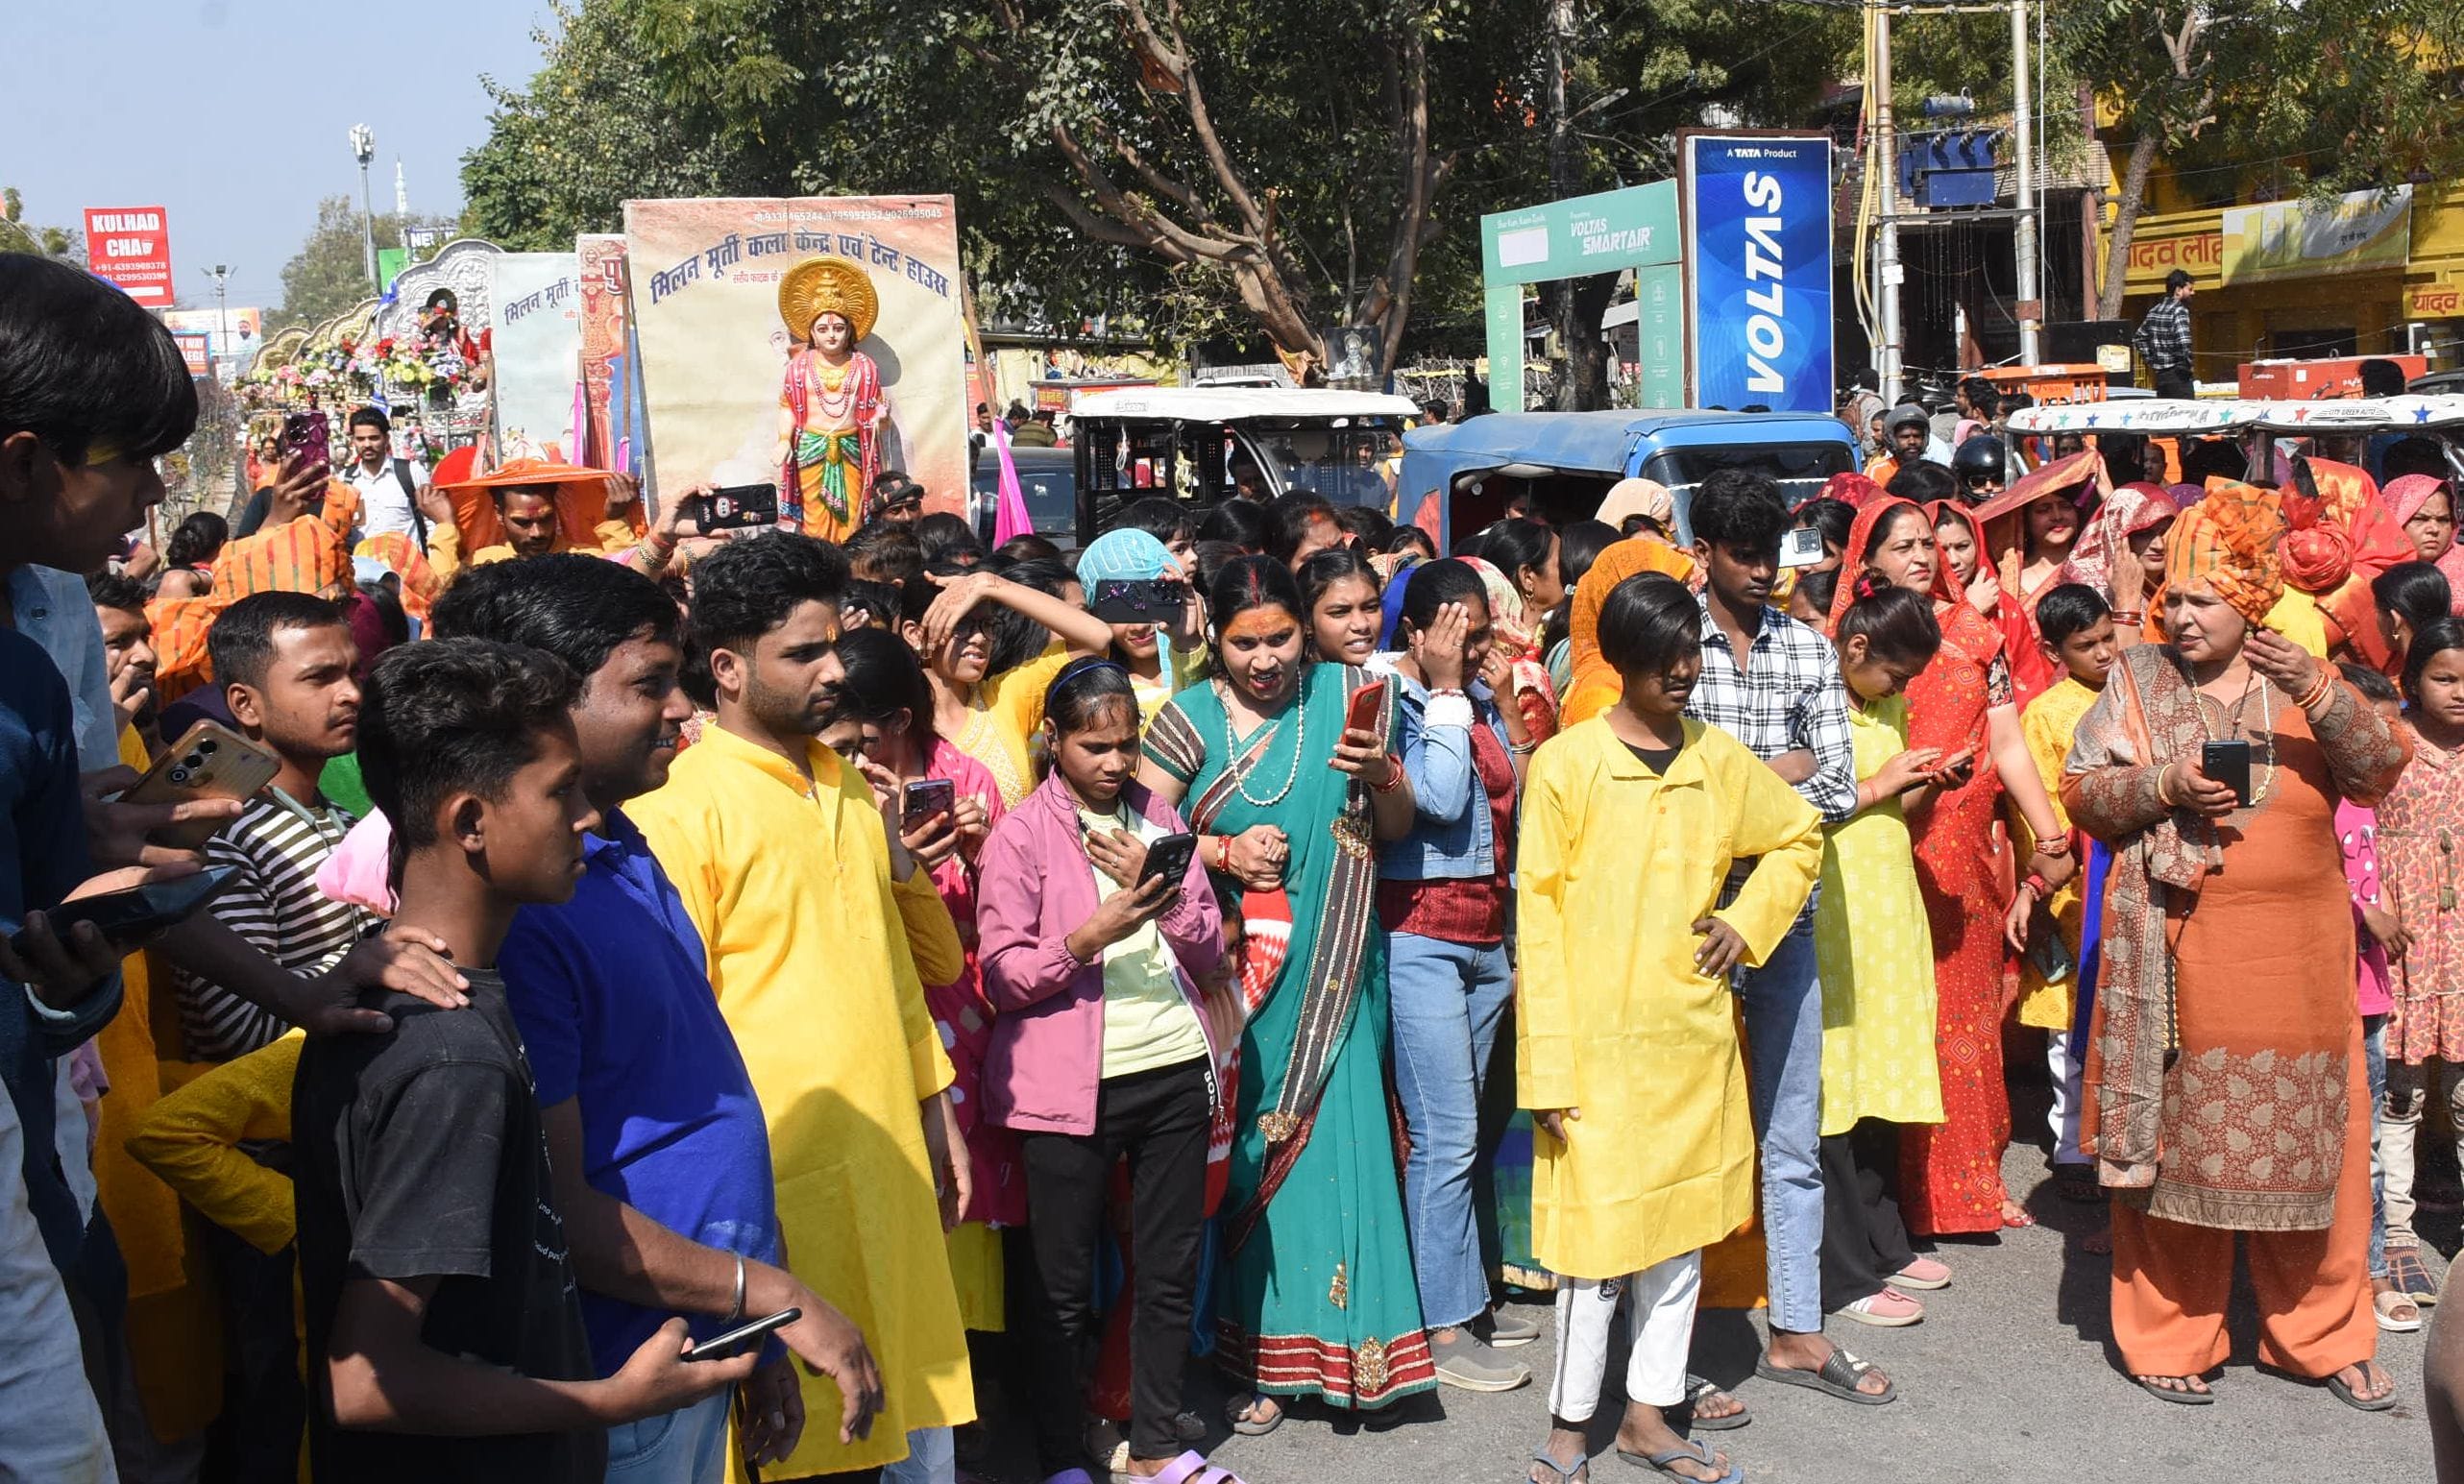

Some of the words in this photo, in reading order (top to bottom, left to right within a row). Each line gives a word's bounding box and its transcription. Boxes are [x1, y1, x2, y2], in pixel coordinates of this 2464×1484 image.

[1727, 149, 1733, 158] A
[1735, 149, 1762, 158] TATA
[1764, 149, 1796, 158] Product
[91, 213, 159, 232] KULHAD
[1571, 218, 1607, 237] VOLTAS
[650, 254, 700, 304] मिलन
[746, 232, 789, 256] कला
[793, 229, 832, 254] केन्द्र
[837, 231, 866, 259] एवं
[868, 235, 900, 272] टेन्ट
[905, 255, 950, 298] हाउस
[1744, 171, 1784, 393] VOLTAS
[504, 291, 540, 326] मिलन
[2412, 292, 2459, 315] यादव
